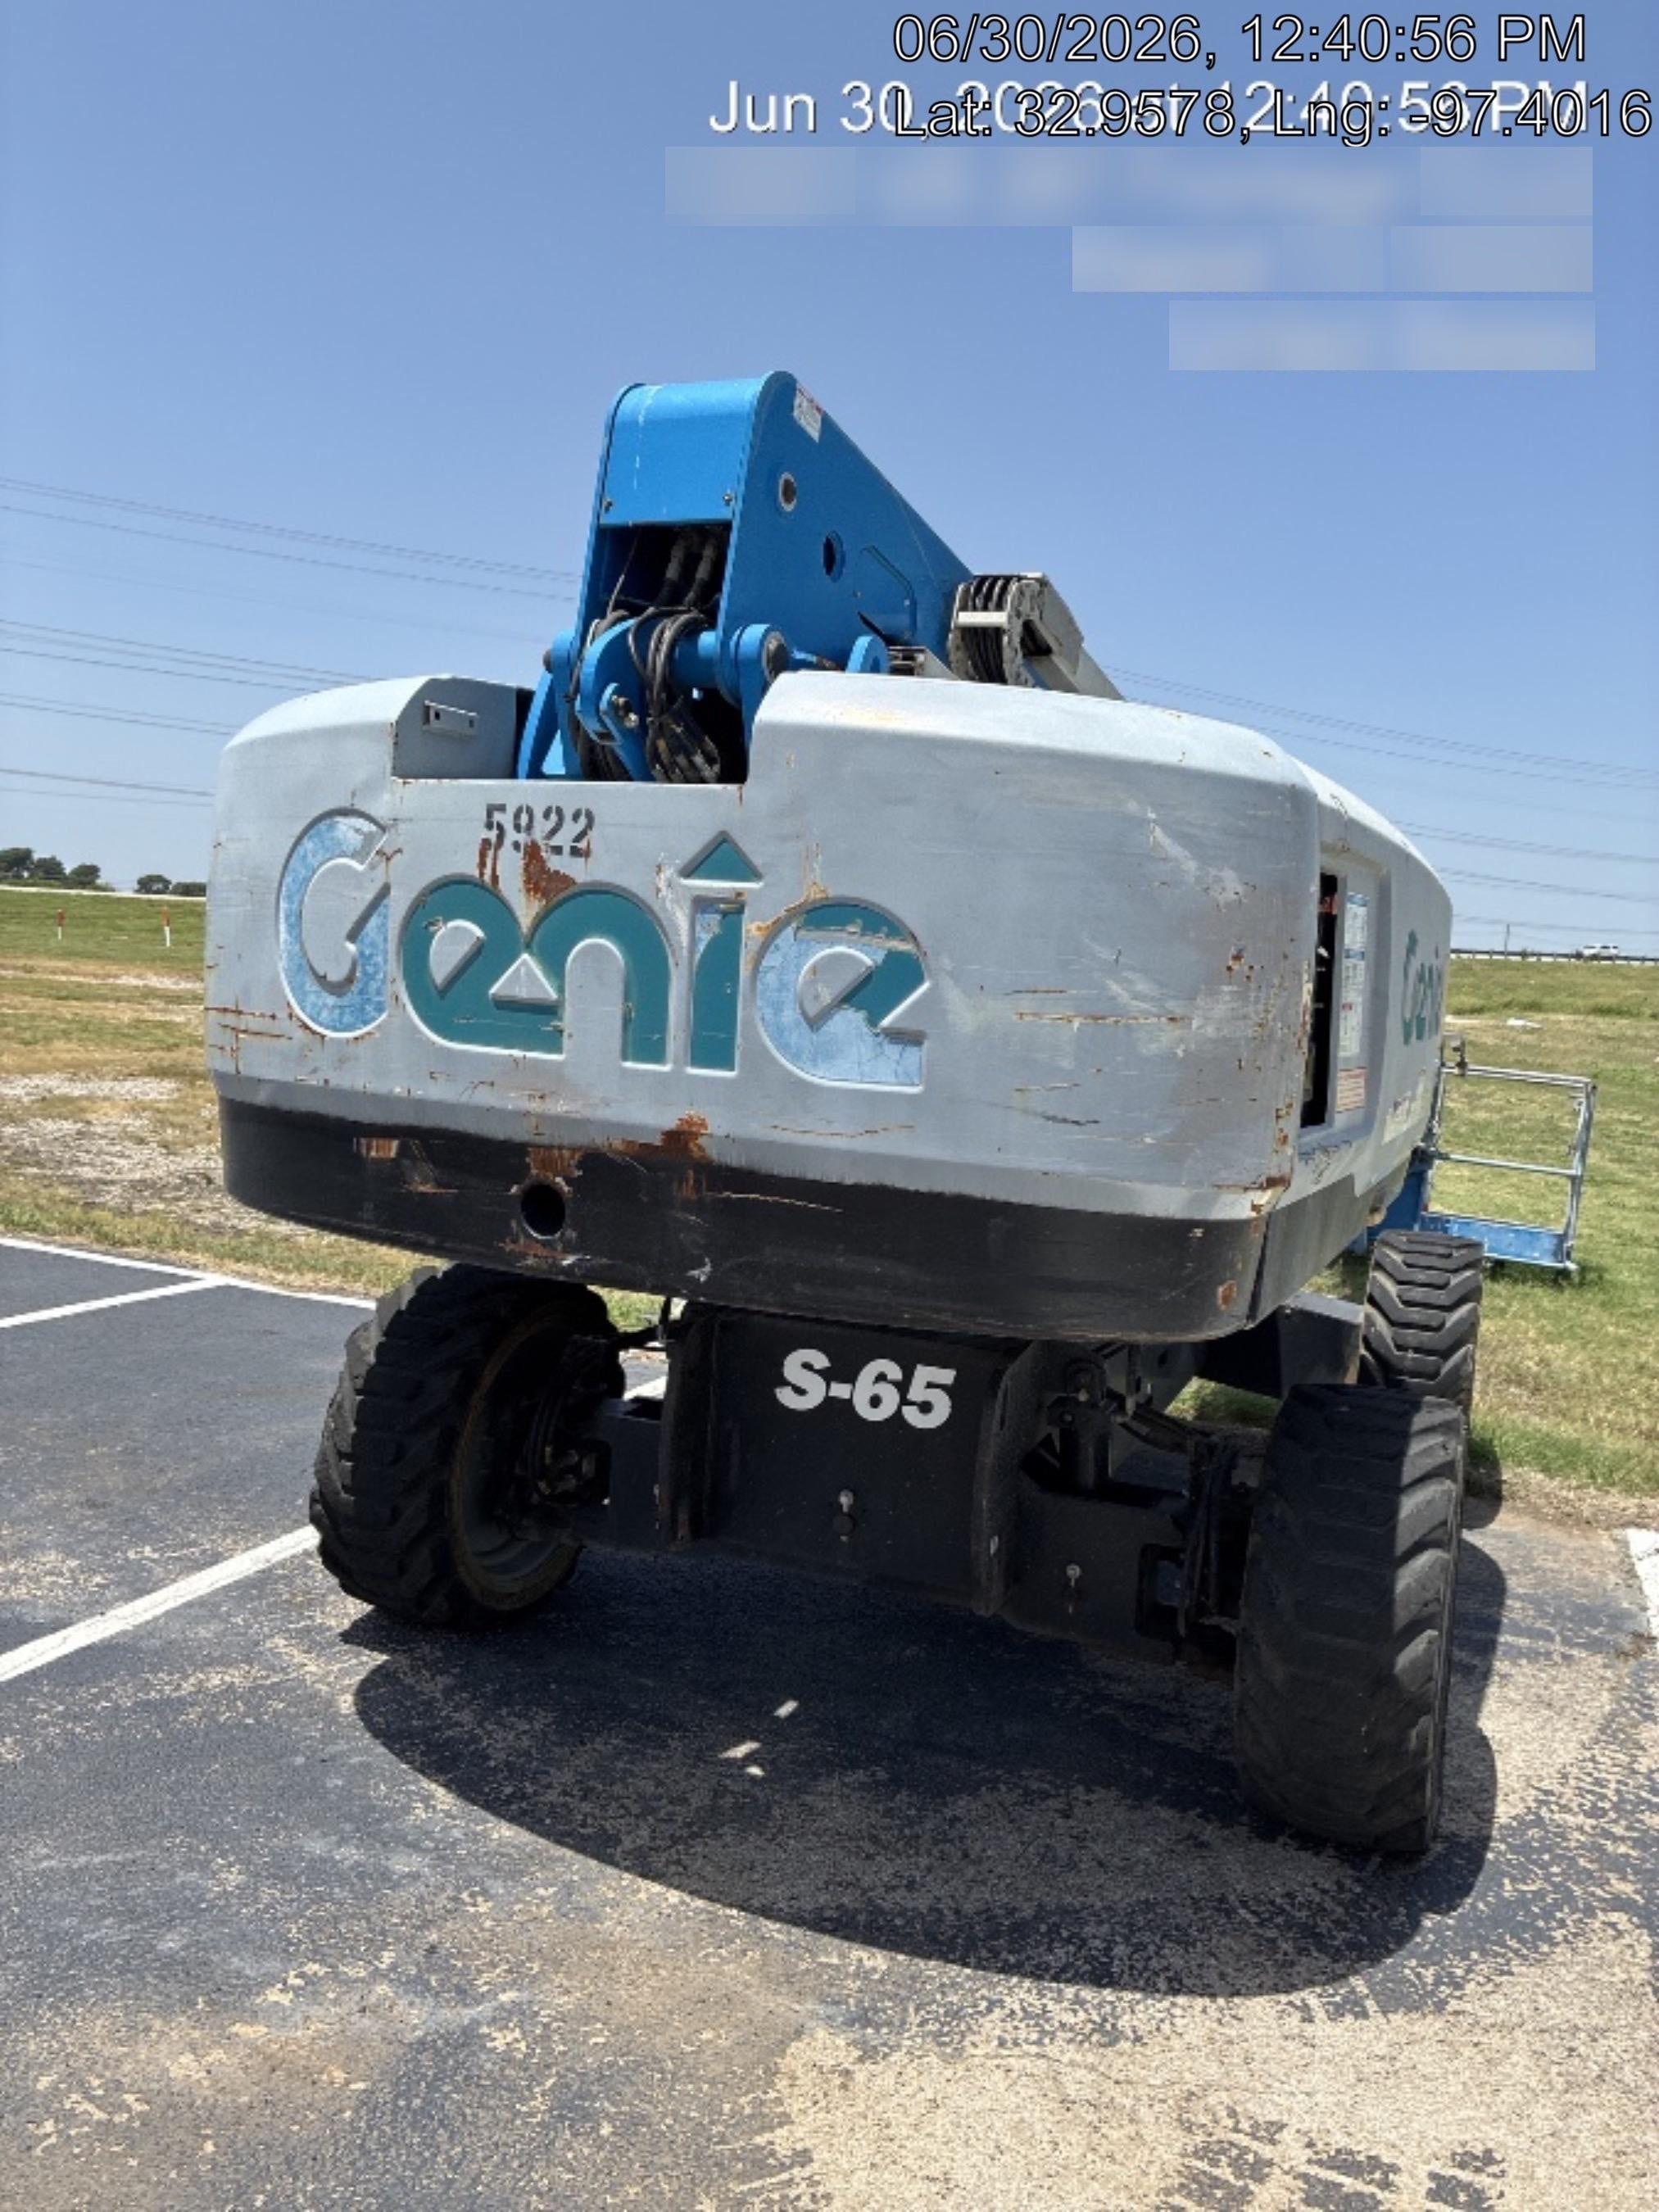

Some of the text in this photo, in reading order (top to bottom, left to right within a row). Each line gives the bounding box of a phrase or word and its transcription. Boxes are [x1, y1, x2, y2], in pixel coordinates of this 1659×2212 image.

[484, 803, 595, 858] 5922
[279, 807, 931, 1091] Genie
[774, 1348, 957, 1430] S-65
